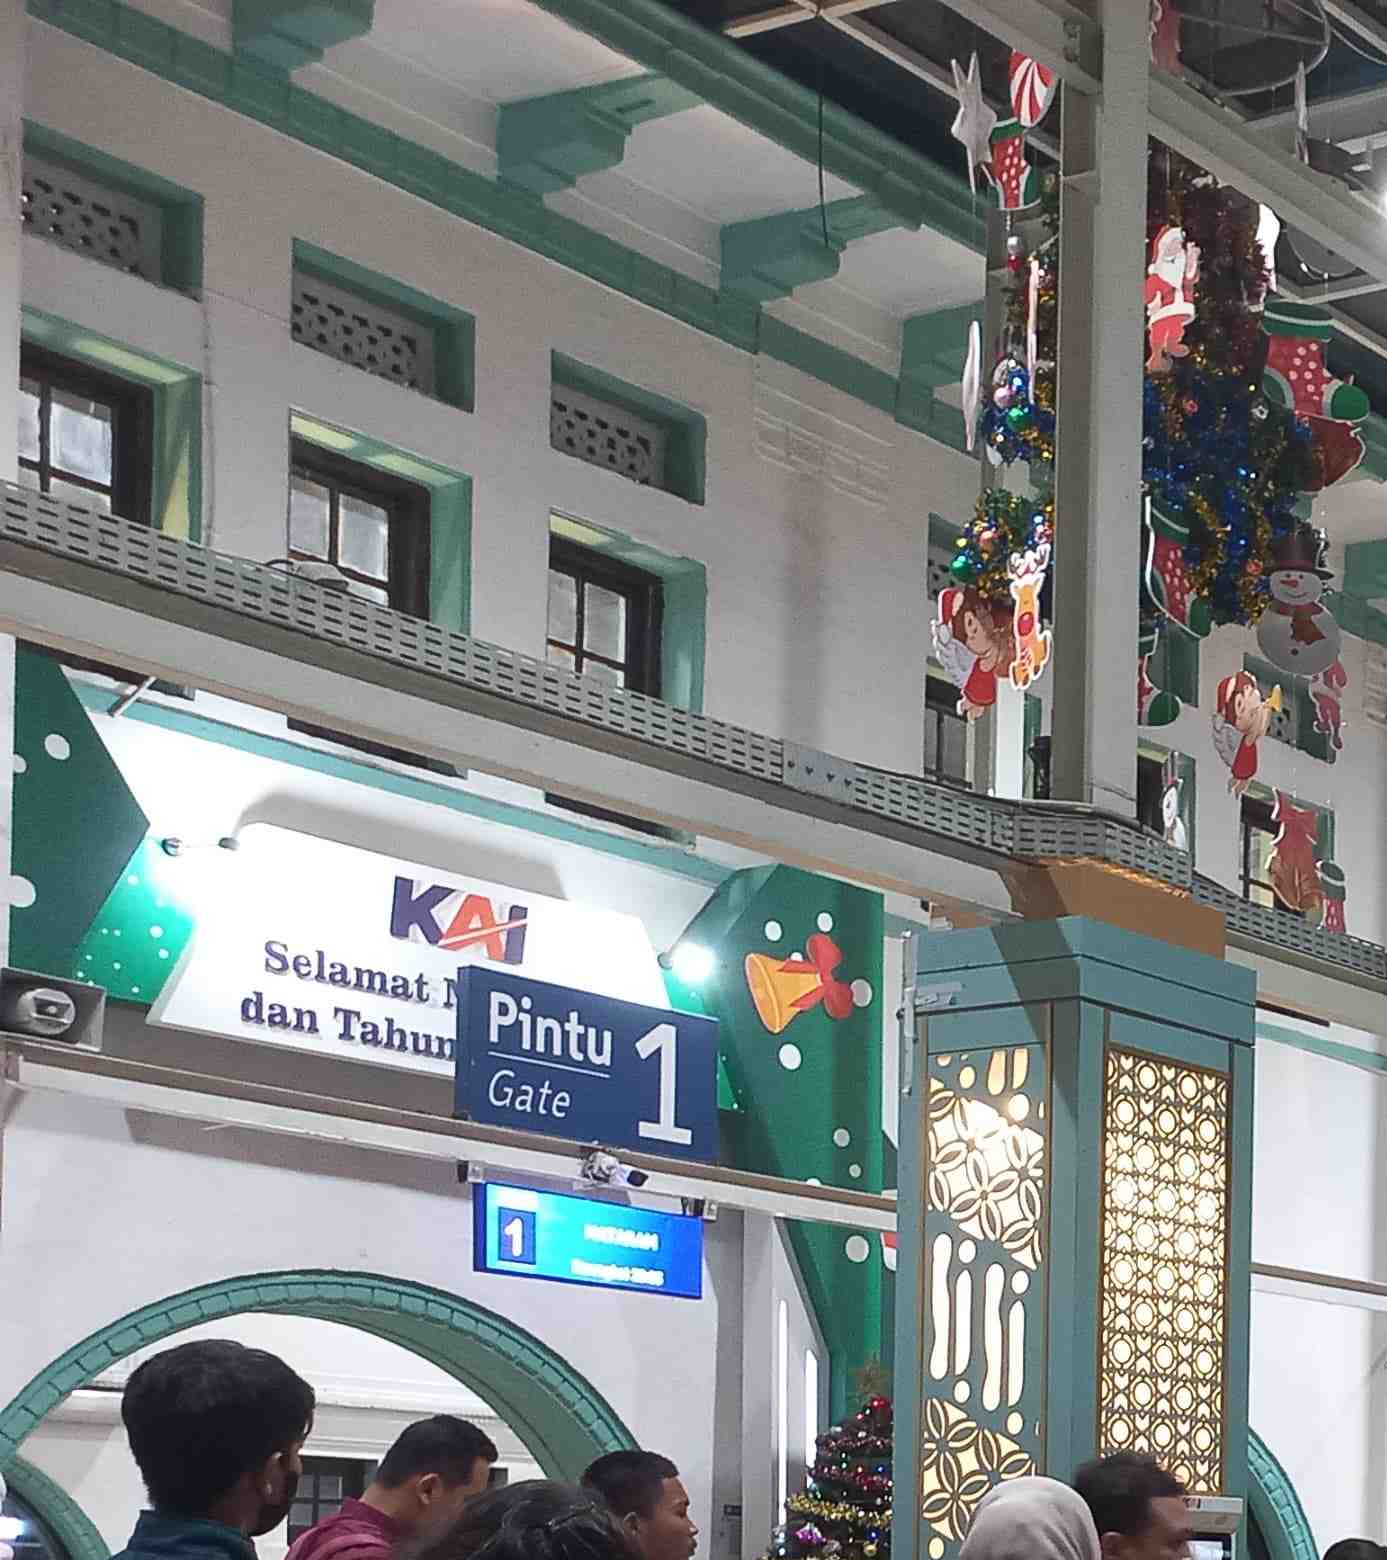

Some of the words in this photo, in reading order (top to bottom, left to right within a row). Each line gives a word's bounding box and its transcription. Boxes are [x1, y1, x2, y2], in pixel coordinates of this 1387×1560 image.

[390, 875, 528, 965] KAI
[263, 940, 430, 1003] Selamat
[240, 991, 319, 1034] dan
[488, 991, 612, 1067] Pintu
[634, 1022, 693, 1146] 1
[488, 1069, 571, 1119] Gate
[503, 1217, 524, 1257] 1
